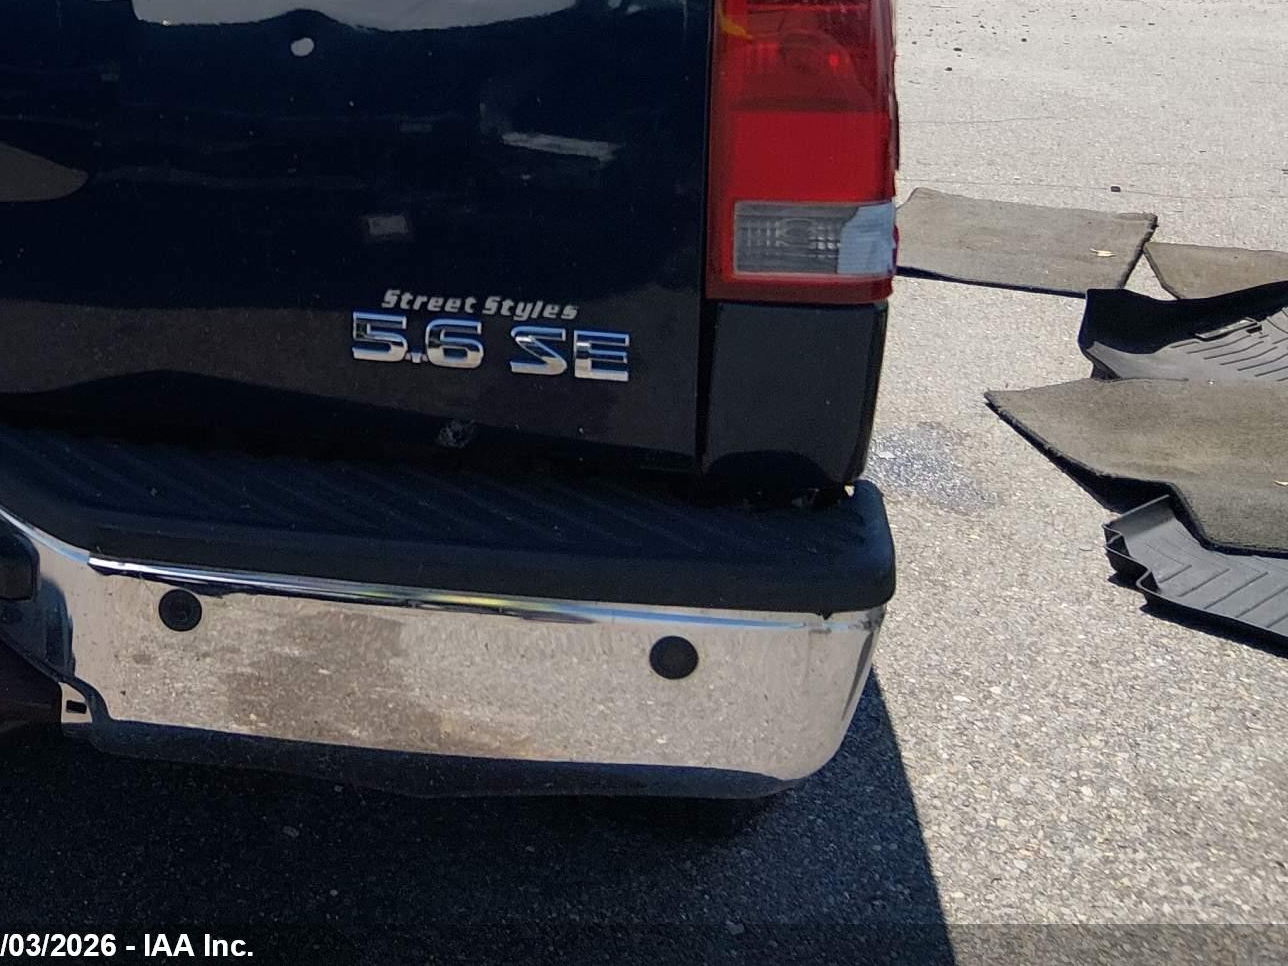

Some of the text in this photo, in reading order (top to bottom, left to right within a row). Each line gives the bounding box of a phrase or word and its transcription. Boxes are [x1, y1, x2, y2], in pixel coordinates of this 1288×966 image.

[381, 289, 579, 321] Street Styles
[351, 311, 630, 382] 5.6 SE
